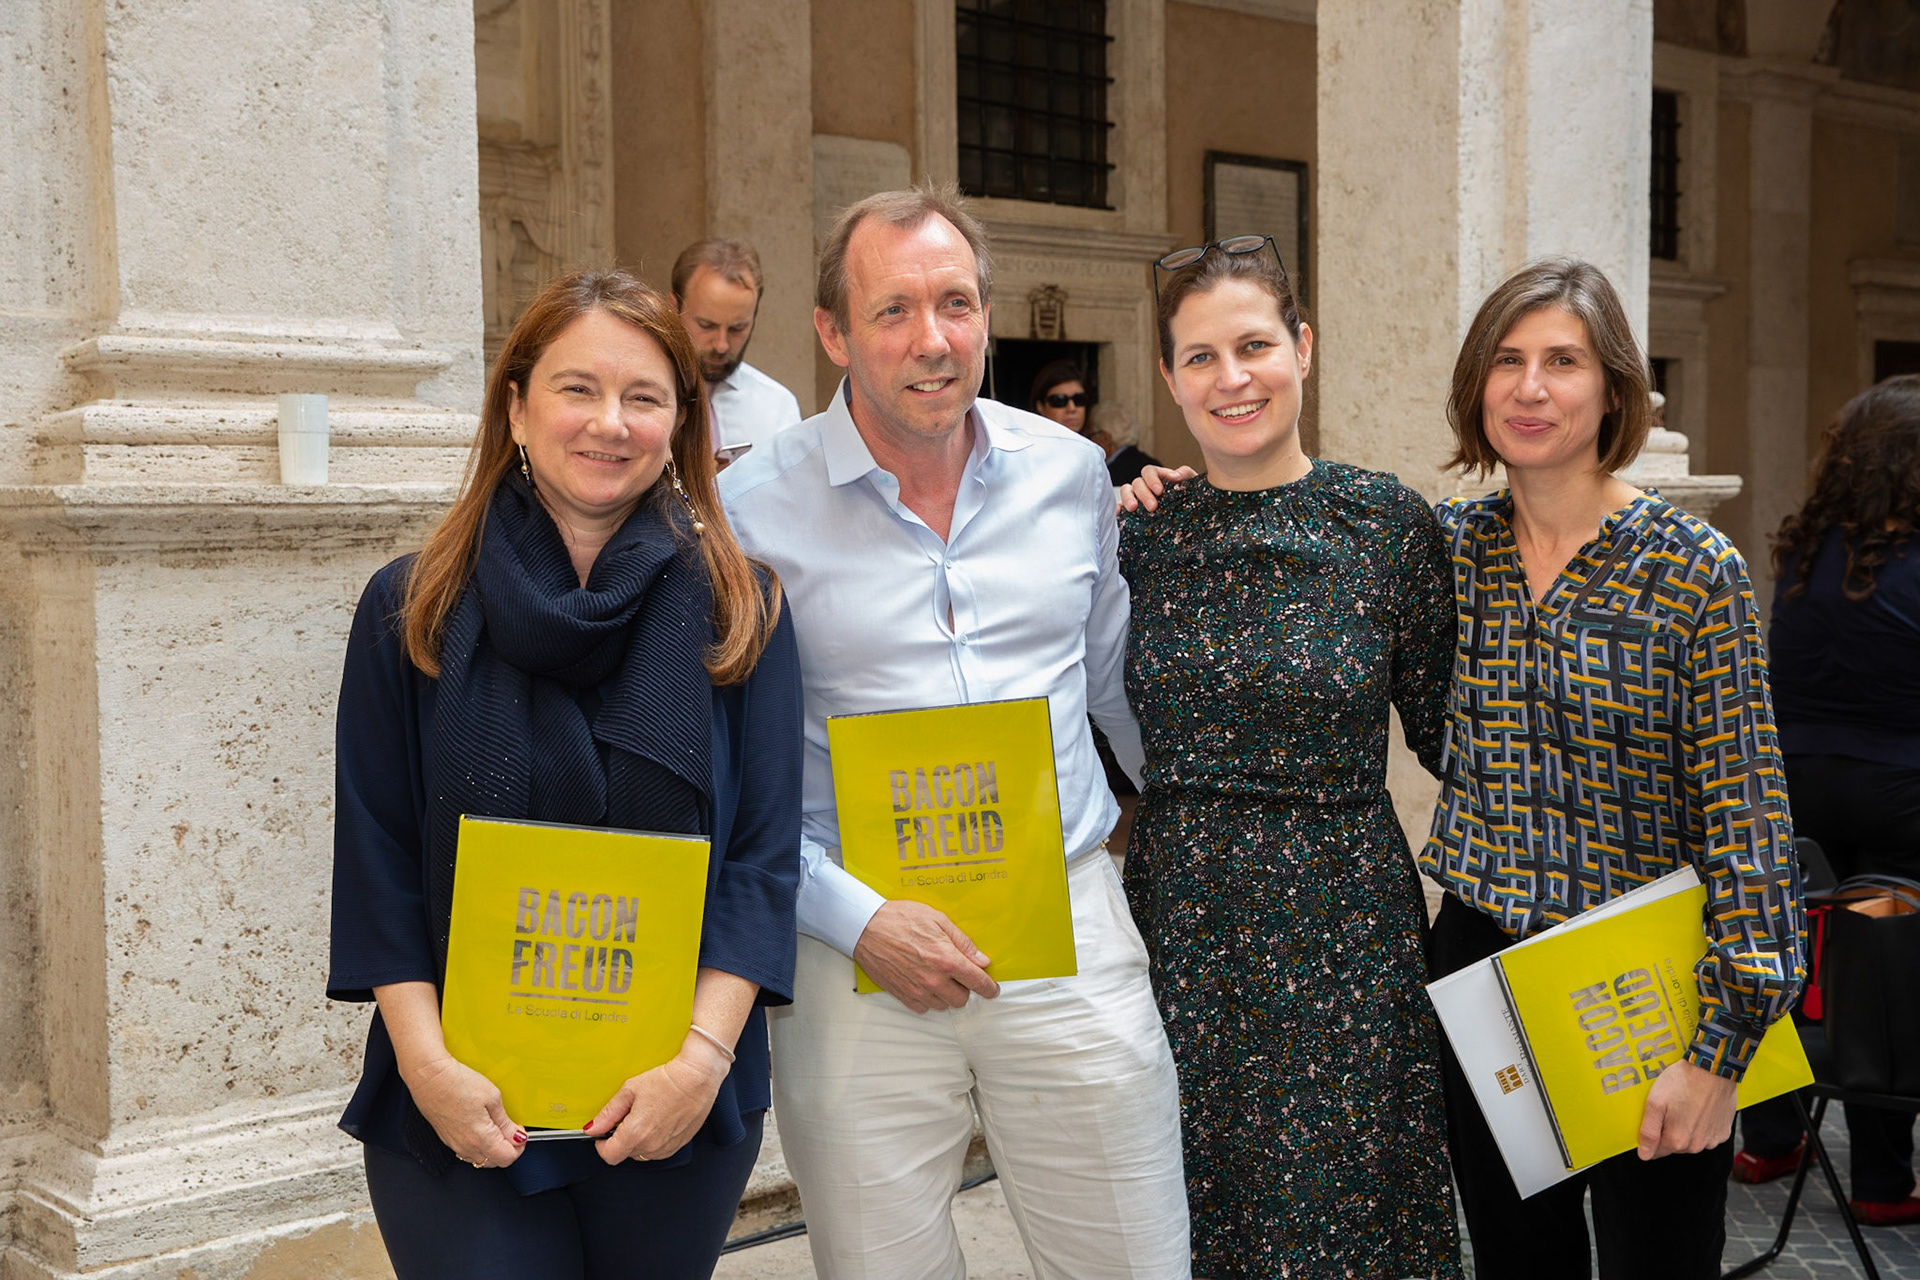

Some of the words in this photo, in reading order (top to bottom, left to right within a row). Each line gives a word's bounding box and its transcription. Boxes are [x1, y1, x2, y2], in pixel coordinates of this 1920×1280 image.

[889, 761, 999, 813] BACON
[894, 810, 1004, 861] FREUD
[901, 877, 915, 888] La
[917, 873, 954, 887] Scuola
[957, 871, 967, 883] di
[970, 869, 1008, 882] Londra
[516, 887, 639, 943] BACON
[510, 939, 633, 994] FREUD
[1665, 957, 1683, 997] Londra
[507, 1003, 523, 1015] La
[525, 1004, 567, 1019] Scuola
[570, 1009, 581, 1020] di
[585, 1009, 628, 1023] Londra
[1678, 997, 1688, 1008] di
[1569, 981, 1641, 1096] BACON
[1516, 1062, 1530, 1084] DART
